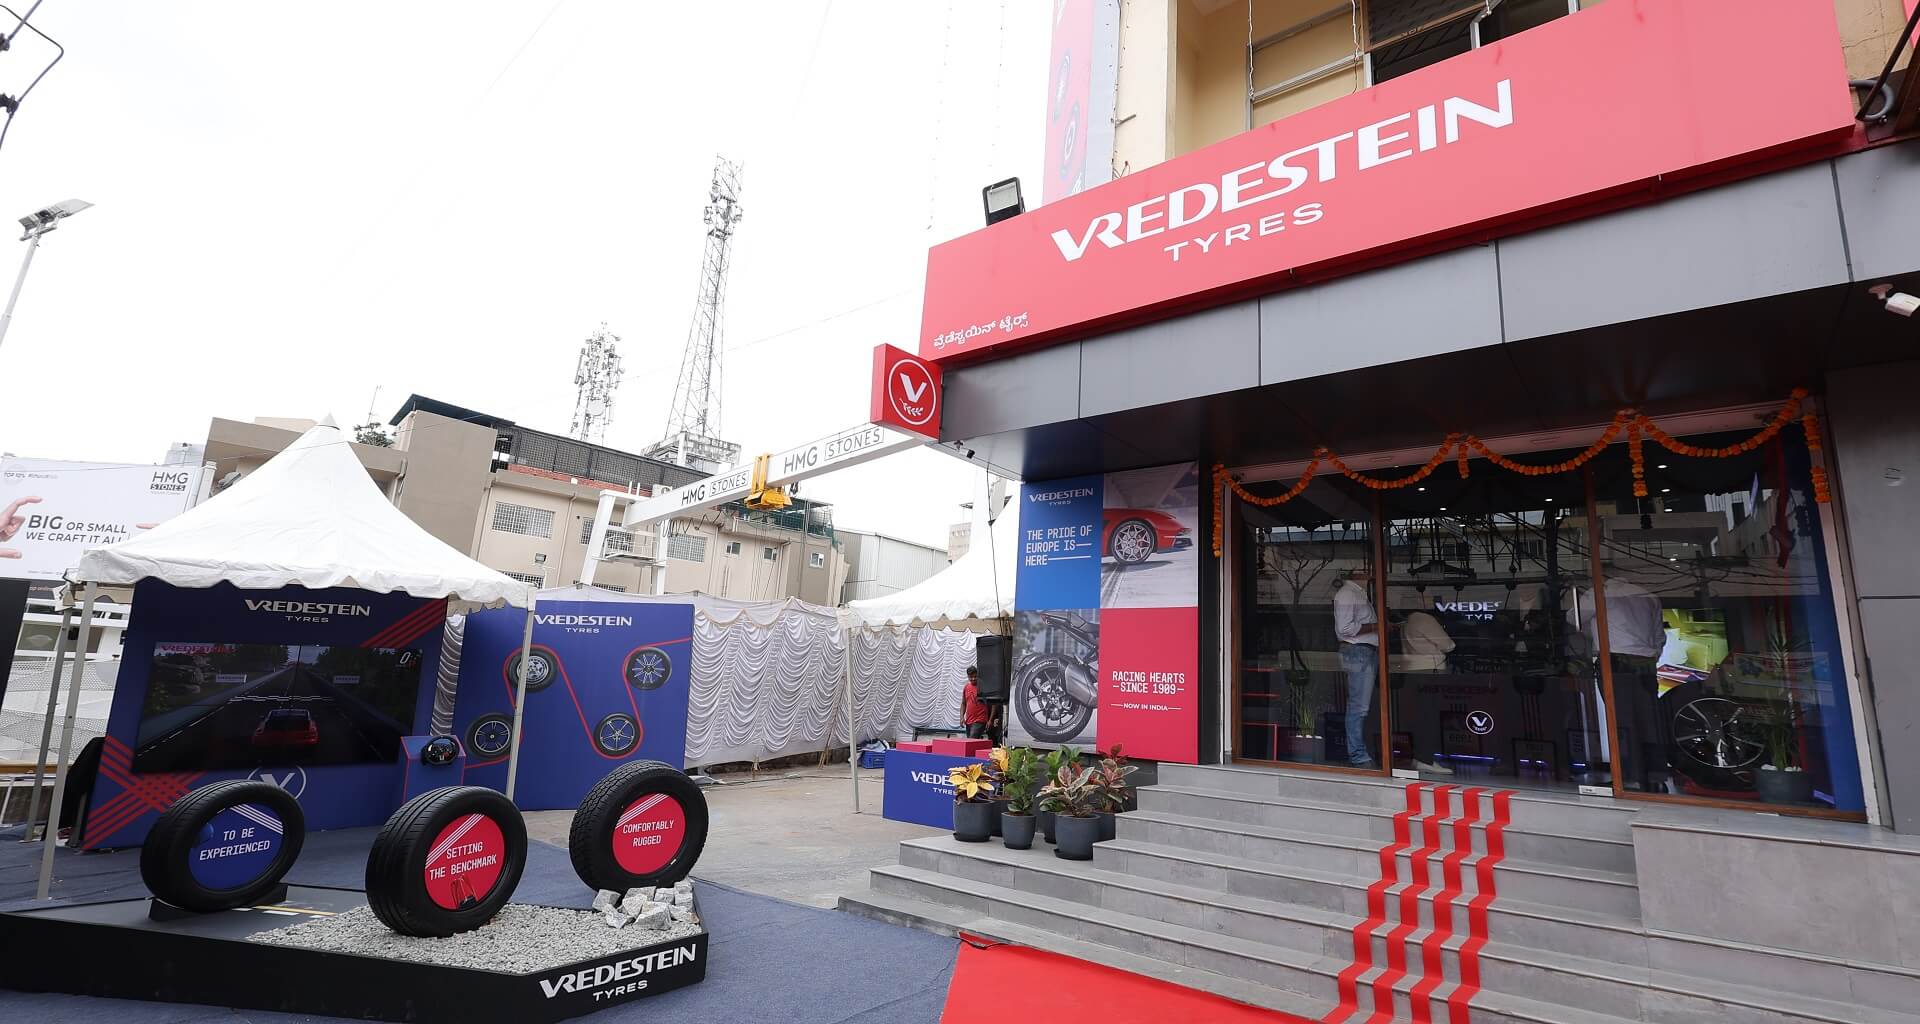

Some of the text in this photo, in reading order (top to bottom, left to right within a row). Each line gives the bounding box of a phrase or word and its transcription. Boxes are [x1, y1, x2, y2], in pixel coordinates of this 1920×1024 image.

[1051, 78, 1514, 262] VREDESTEIN
[1164, 202, 1325, 262] TYRES
[783, 427, 882, 474] HMG STONES
[152, 471, 189, 484] HMG
[681, 472, 748, 506] HMG STONES
[1029, 487, 1094, 502] VREDESTEIN
[28, 514, 127, 534] BIG OR SMALL
[26, 531, 45, 541] WE
[48, 532, 86, 543] CRAFT
[89, 534, 100, 543] IT
[1027, 524, 1093, 541] THE PRIDE OF
[1026, 539, 1076, 554] EUROPE IS
[1025, 554, 1048, 567] HERE
[244, 599, 371, 617] VREDESTEIN
[285, 615, 329, 623] TYRES
[534, 614, 633, 627] VREDESTEIN
[1112, 670, 1185, 684] RACING HEARTS
[1120, 681, 1176, 695] SINCE 1909
[223, 827, 255, 841] TO BE
[623, 819, 675, 834] COMFORTABLY
[632, 834, 662, 847] RUGGED
[199, 840, 271, 861] EXPERIENCED
[446, 841, 483, 860] SETTING
[429, 854, 497, 881] THE BENCHMARK
[539, 943, 697, 999] VREDESTEIN
[593, 979, 648, 1002] TYRES
